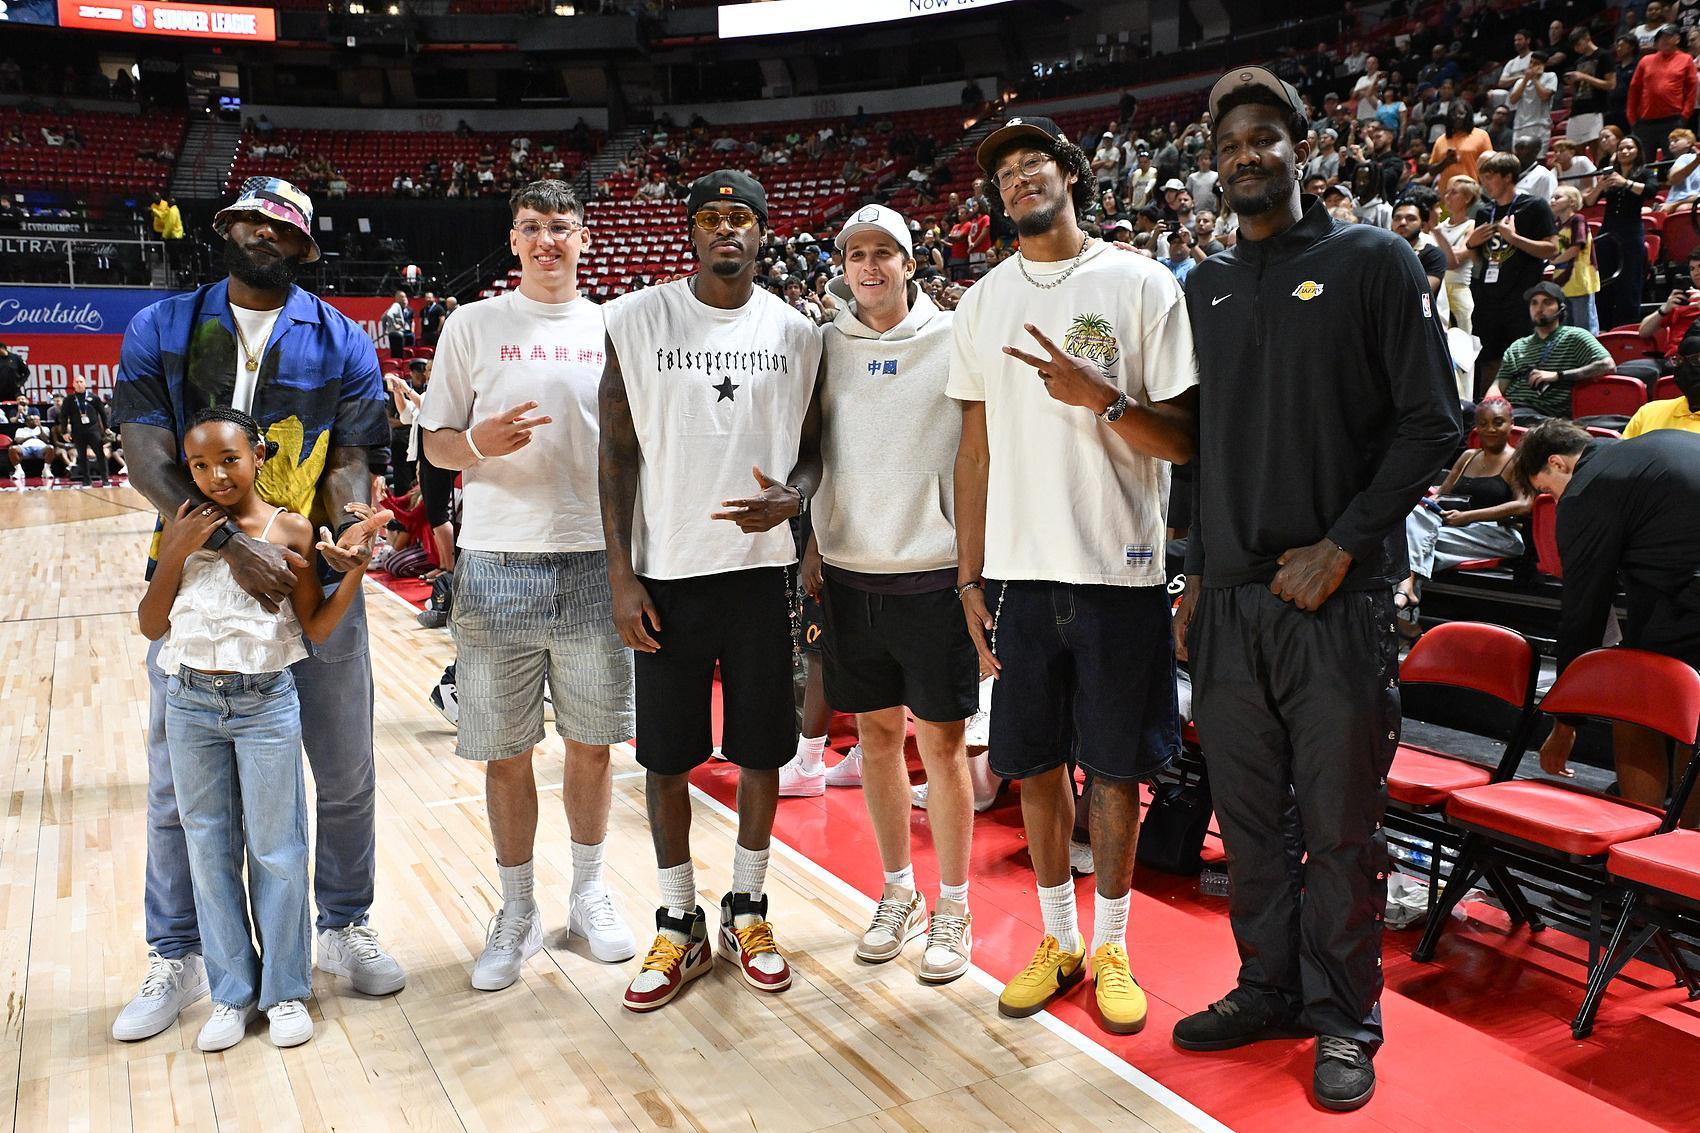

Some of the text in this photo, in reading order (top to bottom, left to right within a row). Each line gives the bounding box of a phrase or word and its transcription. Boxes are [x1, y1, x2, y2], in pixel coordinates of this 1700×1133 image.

[153, 8, 257, 34] SUMMER LEAGUE
[0, 299, 103, 331] Courtside
[867, 359, 898, 375] 中國
